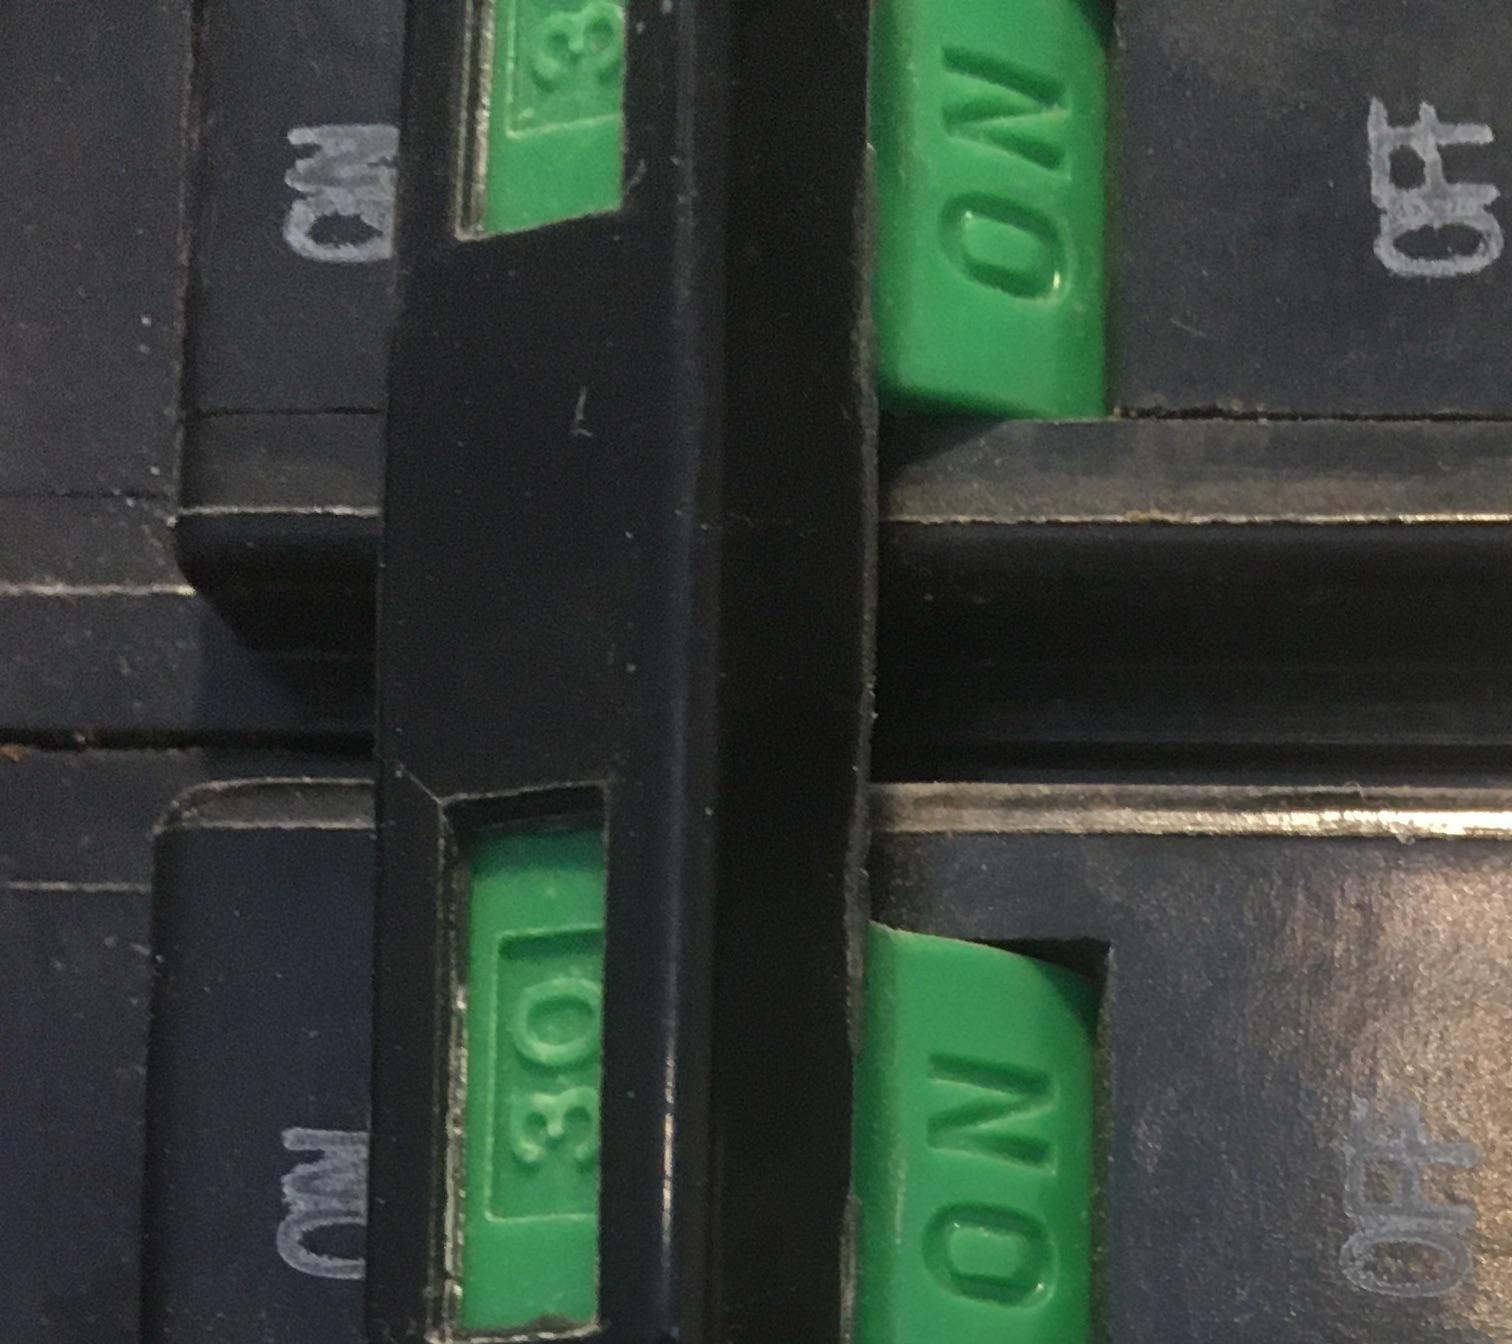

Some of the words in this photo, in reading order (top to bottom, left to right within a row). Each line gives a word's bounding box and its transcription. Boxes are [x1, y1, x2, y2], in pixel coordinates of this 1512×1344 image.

[938, 44, 1071, 304] ON
[508, 977, 601, 1172] 30
[920, 1051, 1057, 1309] ON
